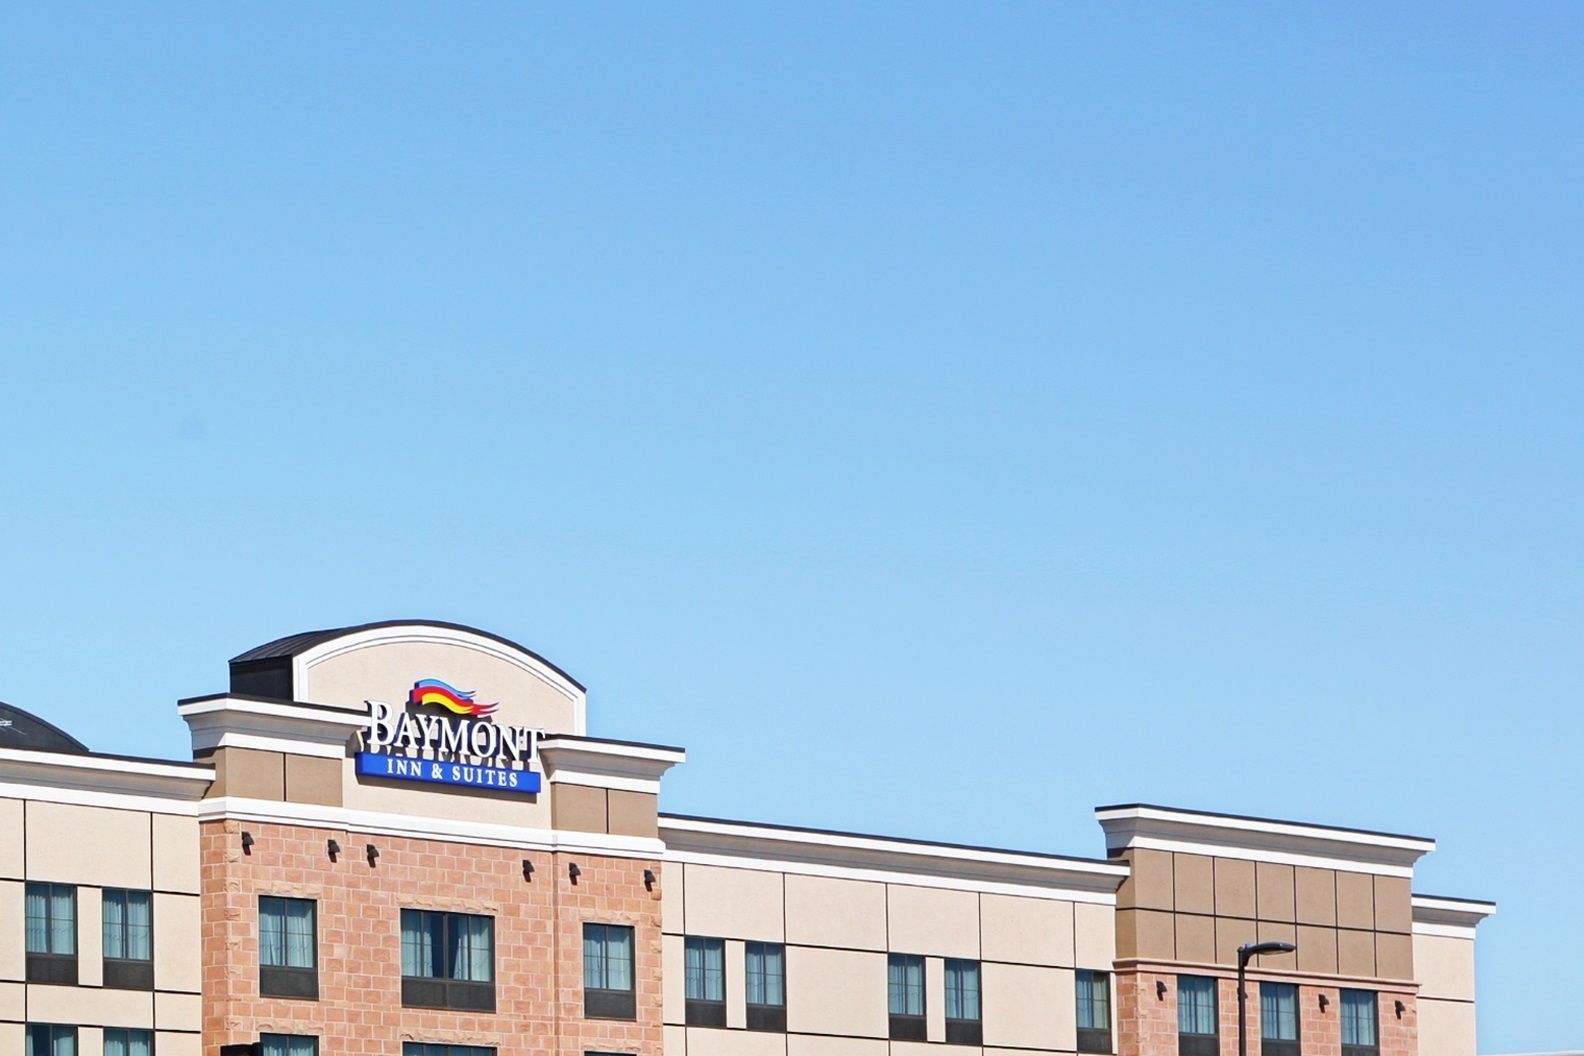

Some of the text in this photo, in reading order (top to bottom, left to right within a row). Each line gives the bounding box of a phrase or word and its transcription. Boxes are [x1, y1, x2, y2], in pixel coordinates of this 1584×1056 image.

[365, 700, 546, 764] BAYMONT
[387, 758, 518, 788] INN & SUITES
